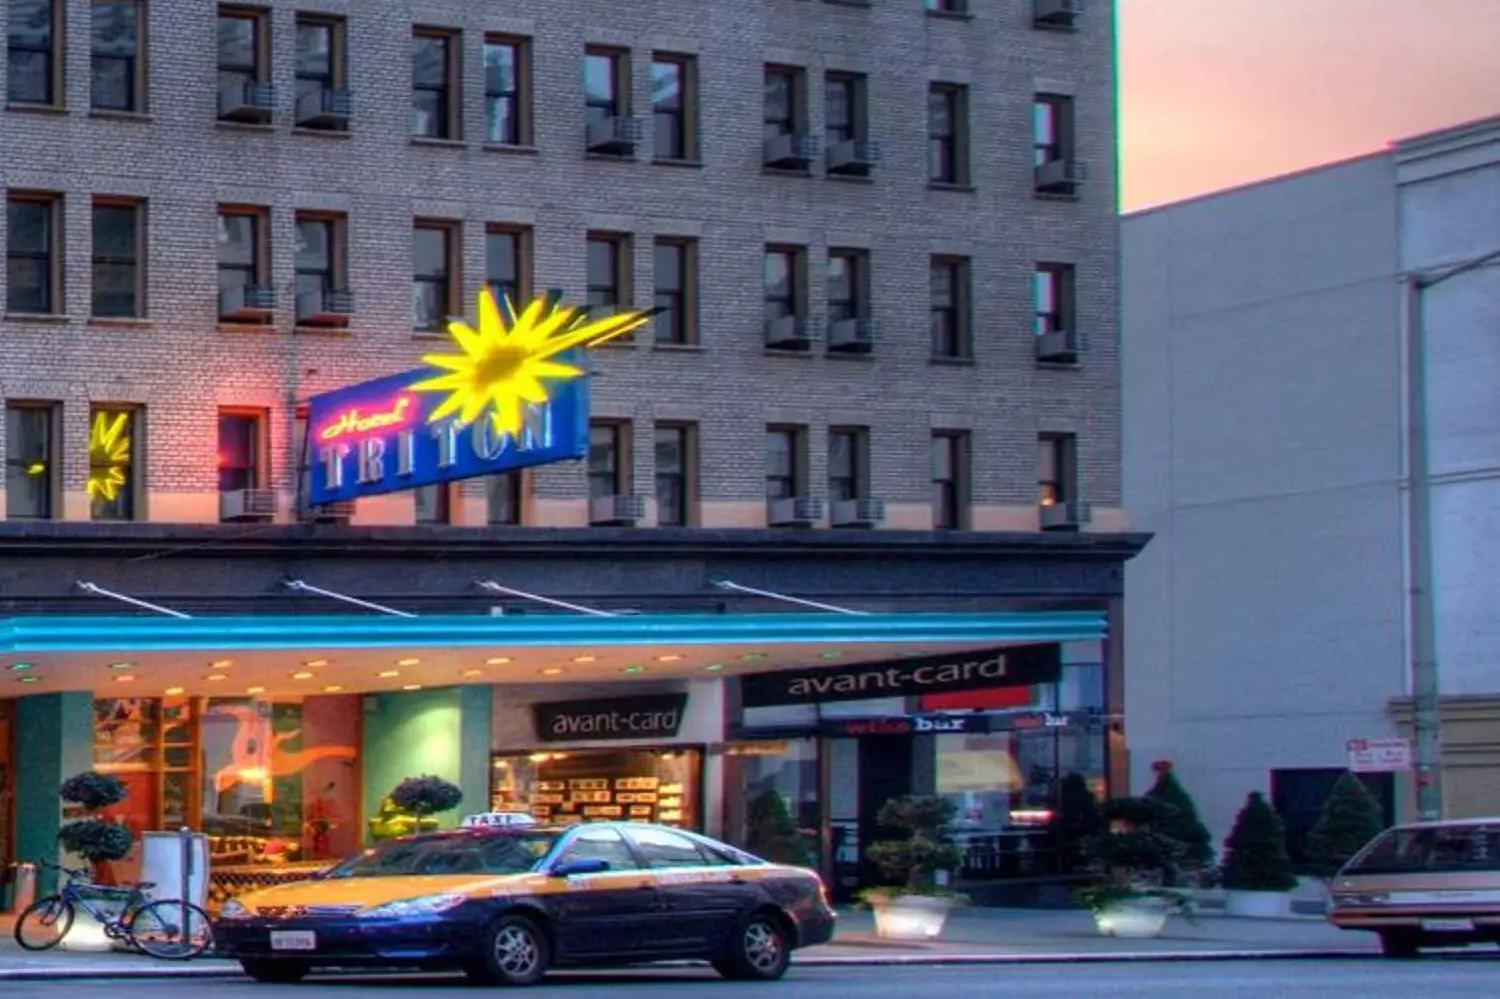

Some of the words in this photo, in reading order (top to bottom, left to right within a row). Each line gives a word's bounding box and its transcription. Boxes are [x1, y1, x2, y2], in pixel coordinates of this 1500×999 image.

[321, 397, 410, 439] Hotel
[320, 402, 553, 490] TRITON
[788, 655, 1006, 696] avant-card
[553, 706, 677, 734] avant-card
[914, 717, 965, 731] bar
[470, 814, 512, 826] TAXI
